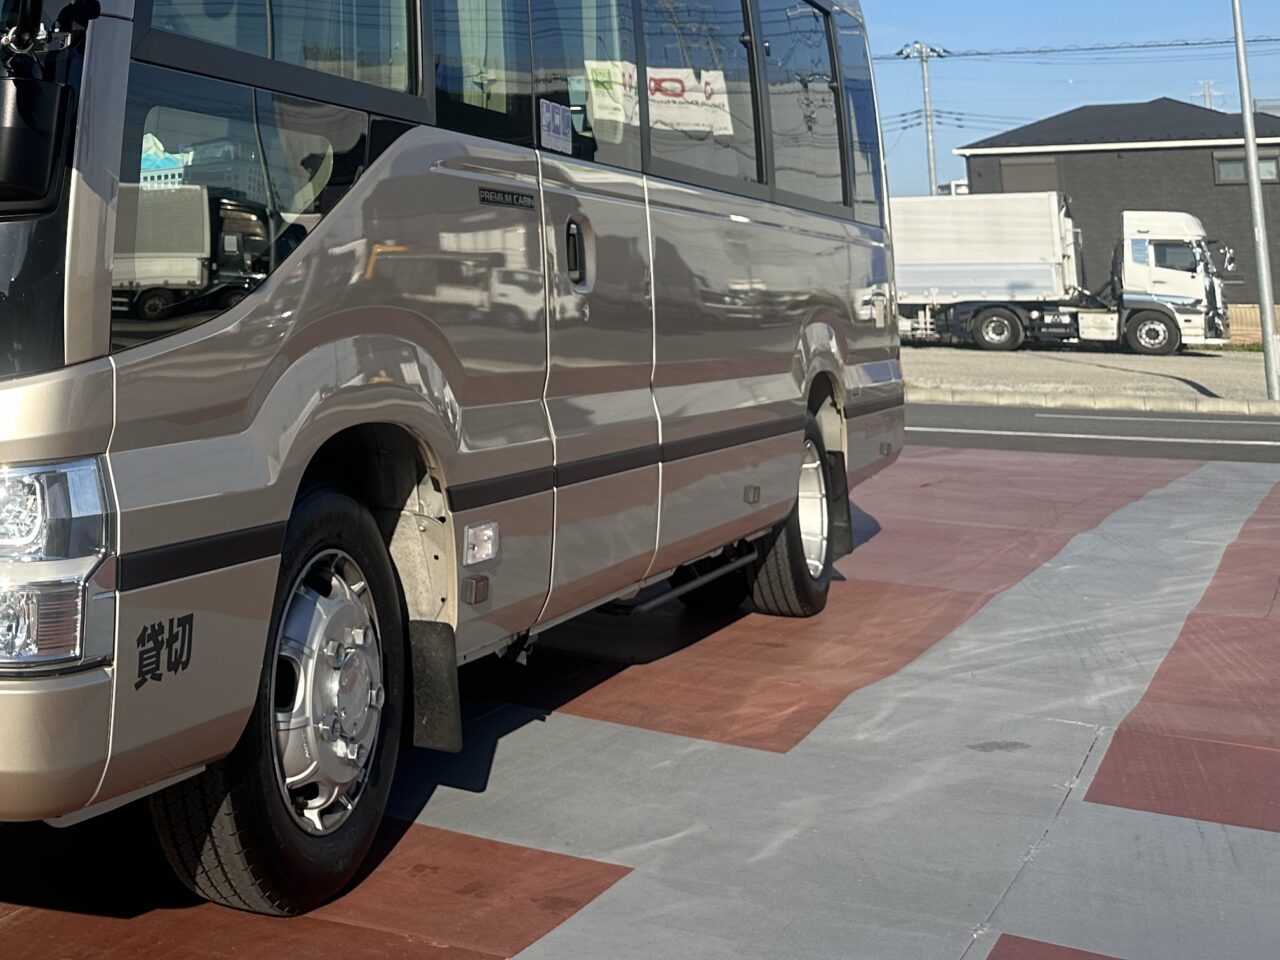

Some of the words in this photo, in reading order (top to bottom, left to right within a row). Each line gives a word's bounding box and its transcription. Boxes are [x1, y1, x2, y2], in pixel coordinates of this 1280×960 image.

[480, 190, 512, 204] PREMIUM
[513, 195, 535, 208] CABIN
[134, 612, 194, 691] 貸切
